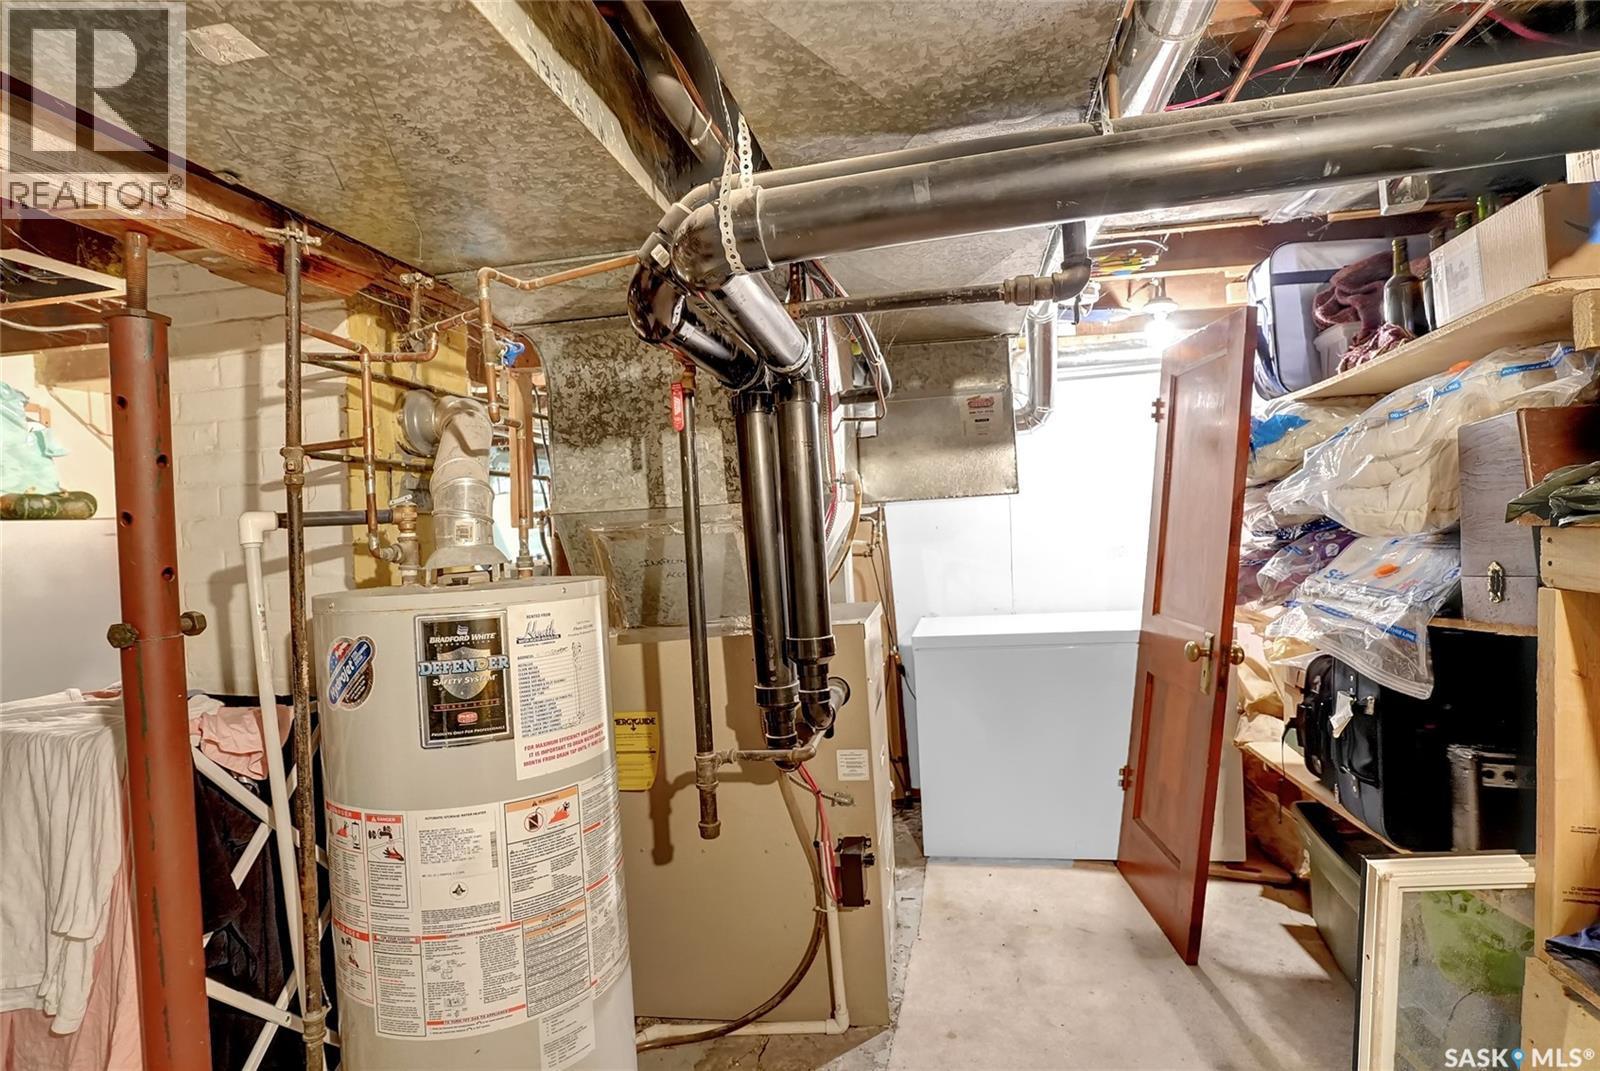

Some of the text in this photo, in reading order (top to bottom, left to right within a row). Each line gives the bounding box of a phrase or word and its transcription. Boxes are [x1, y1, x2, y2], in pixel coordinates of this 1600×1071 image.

[429, 632, 496, 644] BRADFORD WHITE
[418, 655, 510, 676] DEFENDER
[474, 725, 505, 733] PROFESSIONALS
[535, 739, 558, 749] MAXIMUM
[559, 733, 580, 743] EFFICIENCY
[541, 745, 566, 755] IMPORTANT
[523, 759, 541, 767] MONTH
[542, 754, 556, 762] FROM
[556, 751, 569, 759] DRAIN
